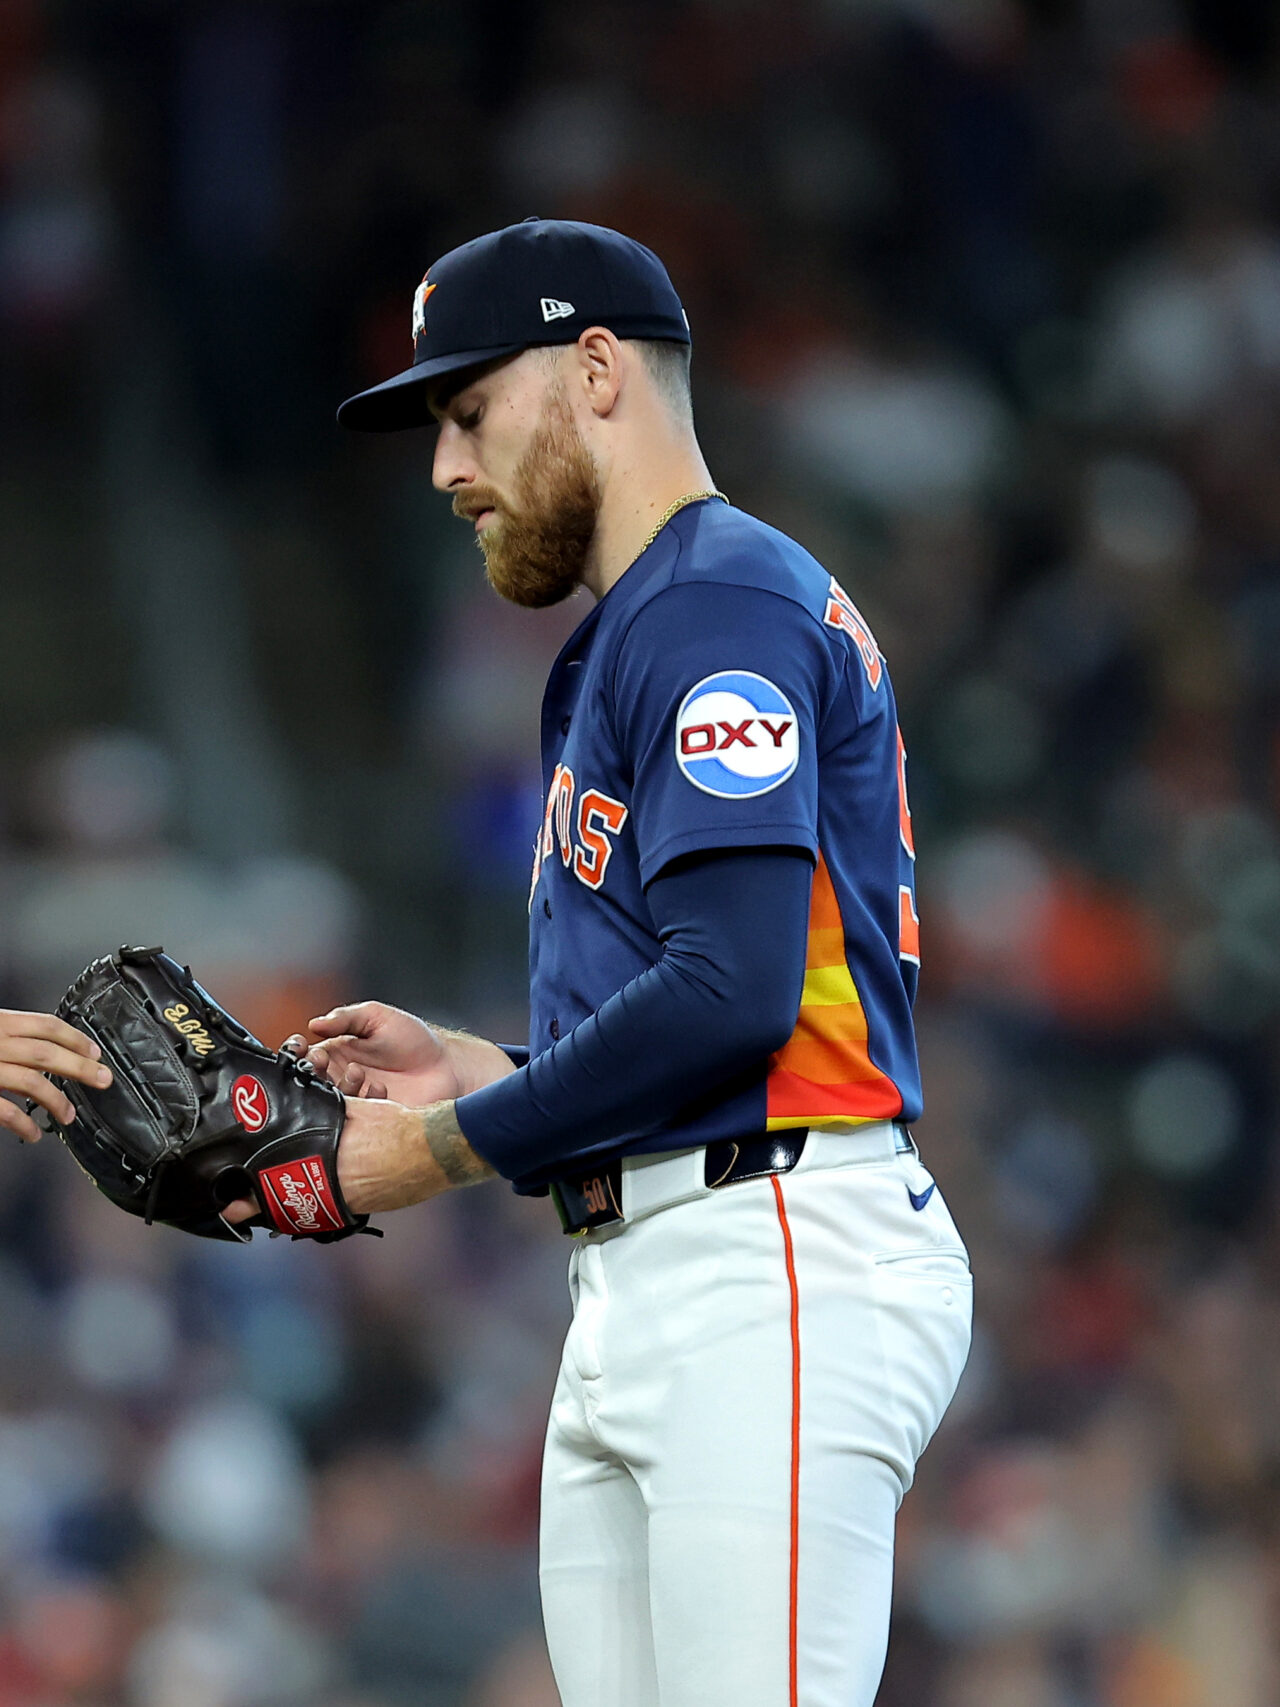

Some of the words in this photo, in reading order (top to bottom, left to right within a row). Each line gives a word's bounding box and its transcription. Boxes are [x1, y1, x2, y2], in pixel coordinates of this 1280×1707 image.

[681, 719, 793, 755] OXY
[235, 1083, 263, 1128] R
[279, 1172, 320, 1230] Rawlings
[583, 1178, 607, 1213] 50
